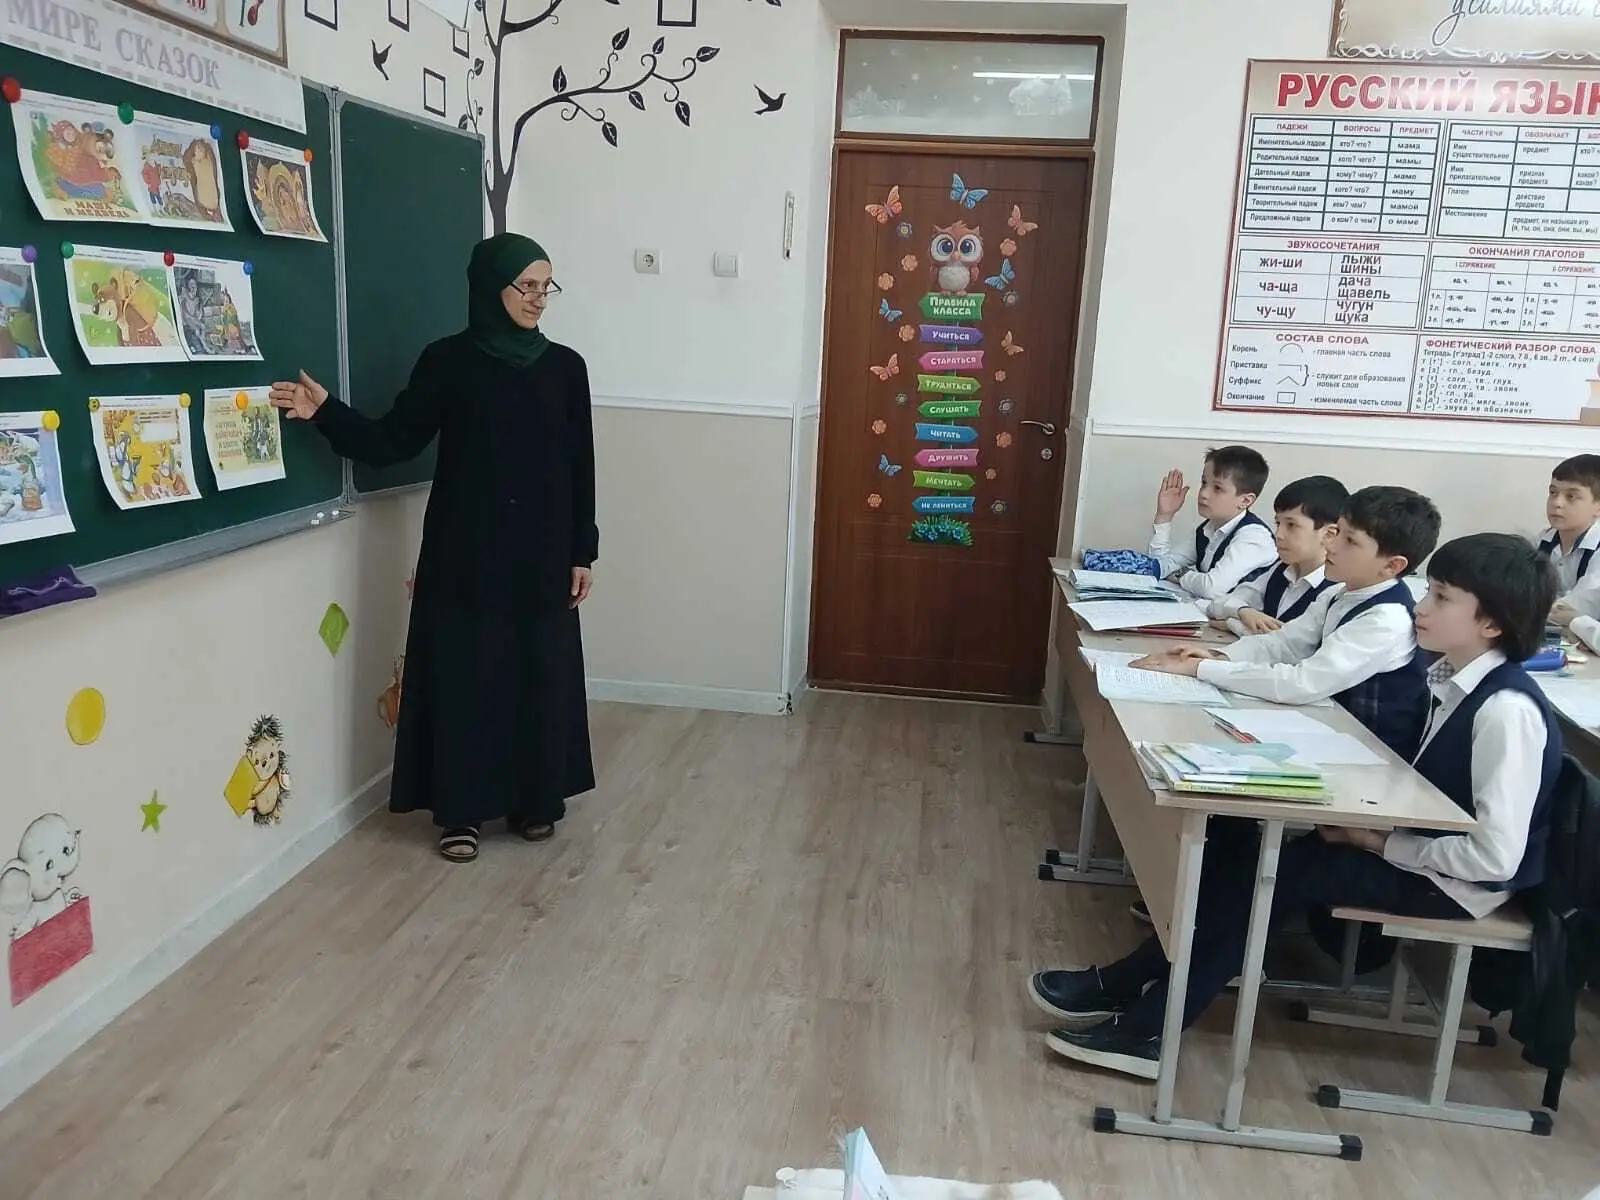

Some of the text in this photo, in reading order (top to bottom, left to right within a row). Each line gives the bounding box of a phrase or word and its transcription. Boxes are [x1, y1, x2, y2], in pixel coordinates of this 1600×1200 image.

[114, 28, 221, 90] СКАЗОК
[1277, 69, 1477, 112] РУССКИЙ
[1256, 153, 1299, 161] Родительный
[1254, 168, 1290, 177] Дательный
[1253, 183, 1297, 191] Винительный
[1252, 198, 1298, 207] Творительный
[1250, 213, 1290, 221] Предложный
[1287, 240, 1380, 251] ЗВУКОСОЧЕТАНИЯ
[1469, 247, 1585, 259] ОКОНЧАНИЯ ГЛАГОЛОВ
[1260, 257, 1303, 269] жи-ши
[1340, 255, 1382, 265] лыжи
[1340, 264, 1381, 275] шины
[1259, 281, 1298, 293] ча-ща
[1338, 277, 1371, 288] дача
[1337, 288, 1391, 300] щавель
[1256, 305, 1296, 319] чу-щу
[1336, 300, 1374, 313] чугун
[1335, 312, 1369, 325] щука
[1275, 333, 1369, 345] СОСТАВ СЛОВА
[1231, 344, 1258, 353] Корень
[1426, 339, 1596, 354] ФОНЕТИЧЕСКИЙ РАЗБОР СЛОВА
[1347, 350, 1368, 358] часть
[1423, 350, 1452, 358] Тетрадь
[1230, 360, 1268, 370] Приставка
[1228, 376, 1262, 386] Суффикс
[1358, 373, 1406, 383] образования
[1226, 392, 1265, 401] Окончание
[1314, 396, 1402, 407] изменяемая часть слова
